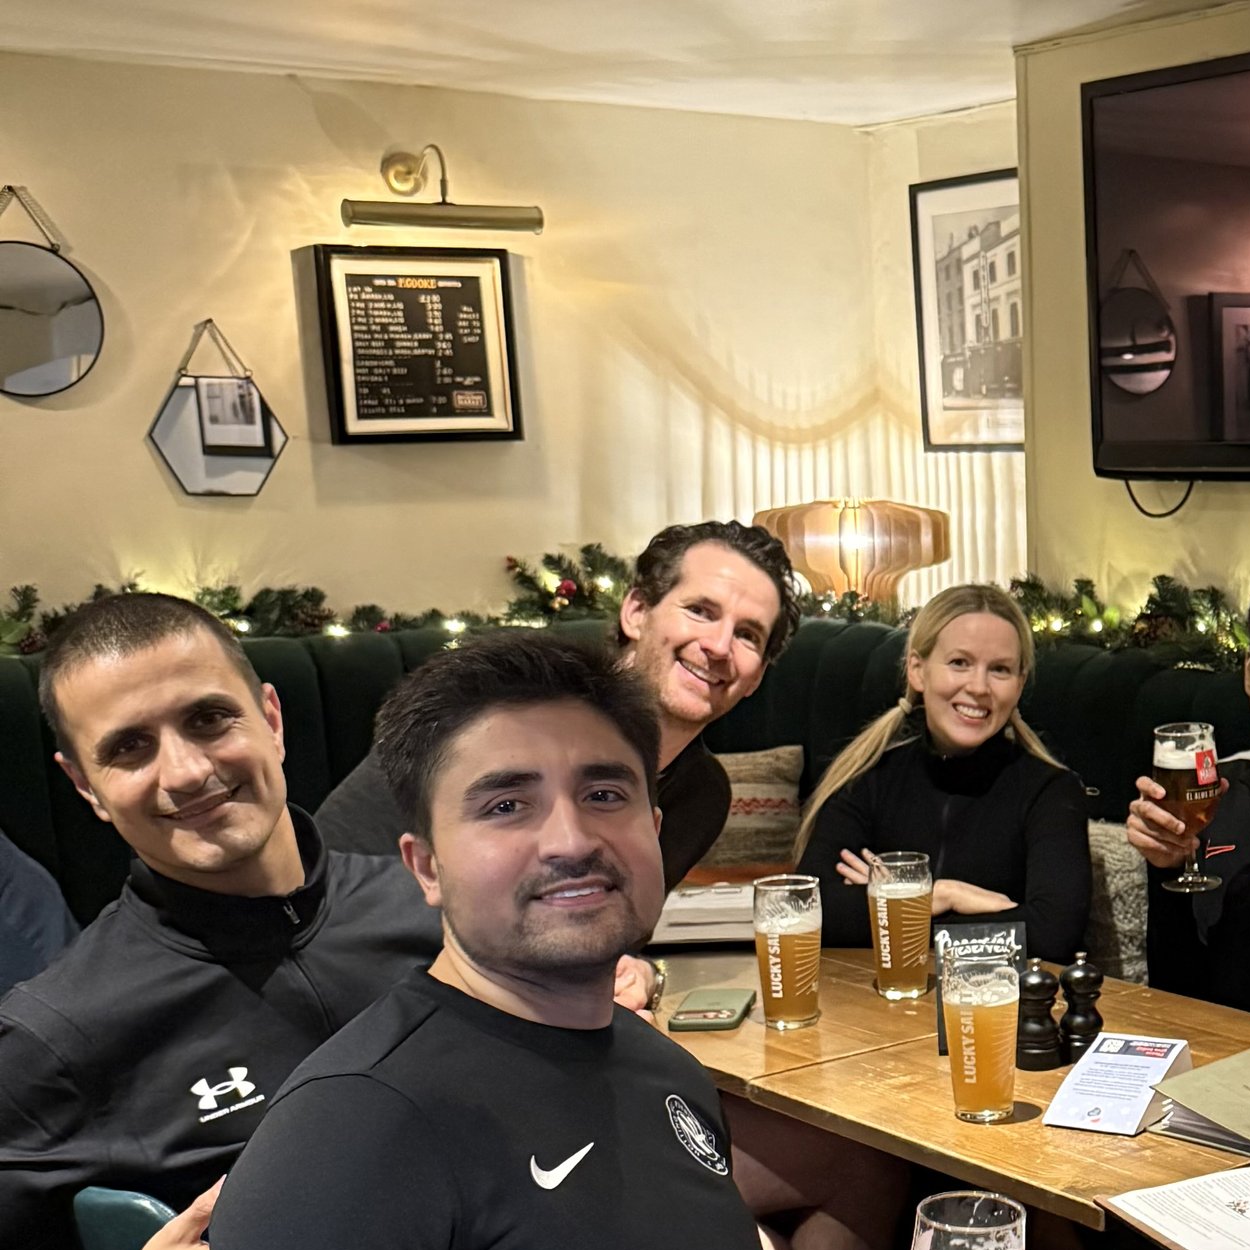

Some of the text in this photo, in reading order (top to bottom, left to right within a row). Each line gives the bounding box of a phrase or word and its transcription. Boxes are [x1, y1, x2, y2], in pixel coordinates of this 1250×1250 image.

[878, 927, 891, 968] LUCKY
[769, 955, 783, 998] LUCKY
[962, 1036, 977, 1084] LUCKY
